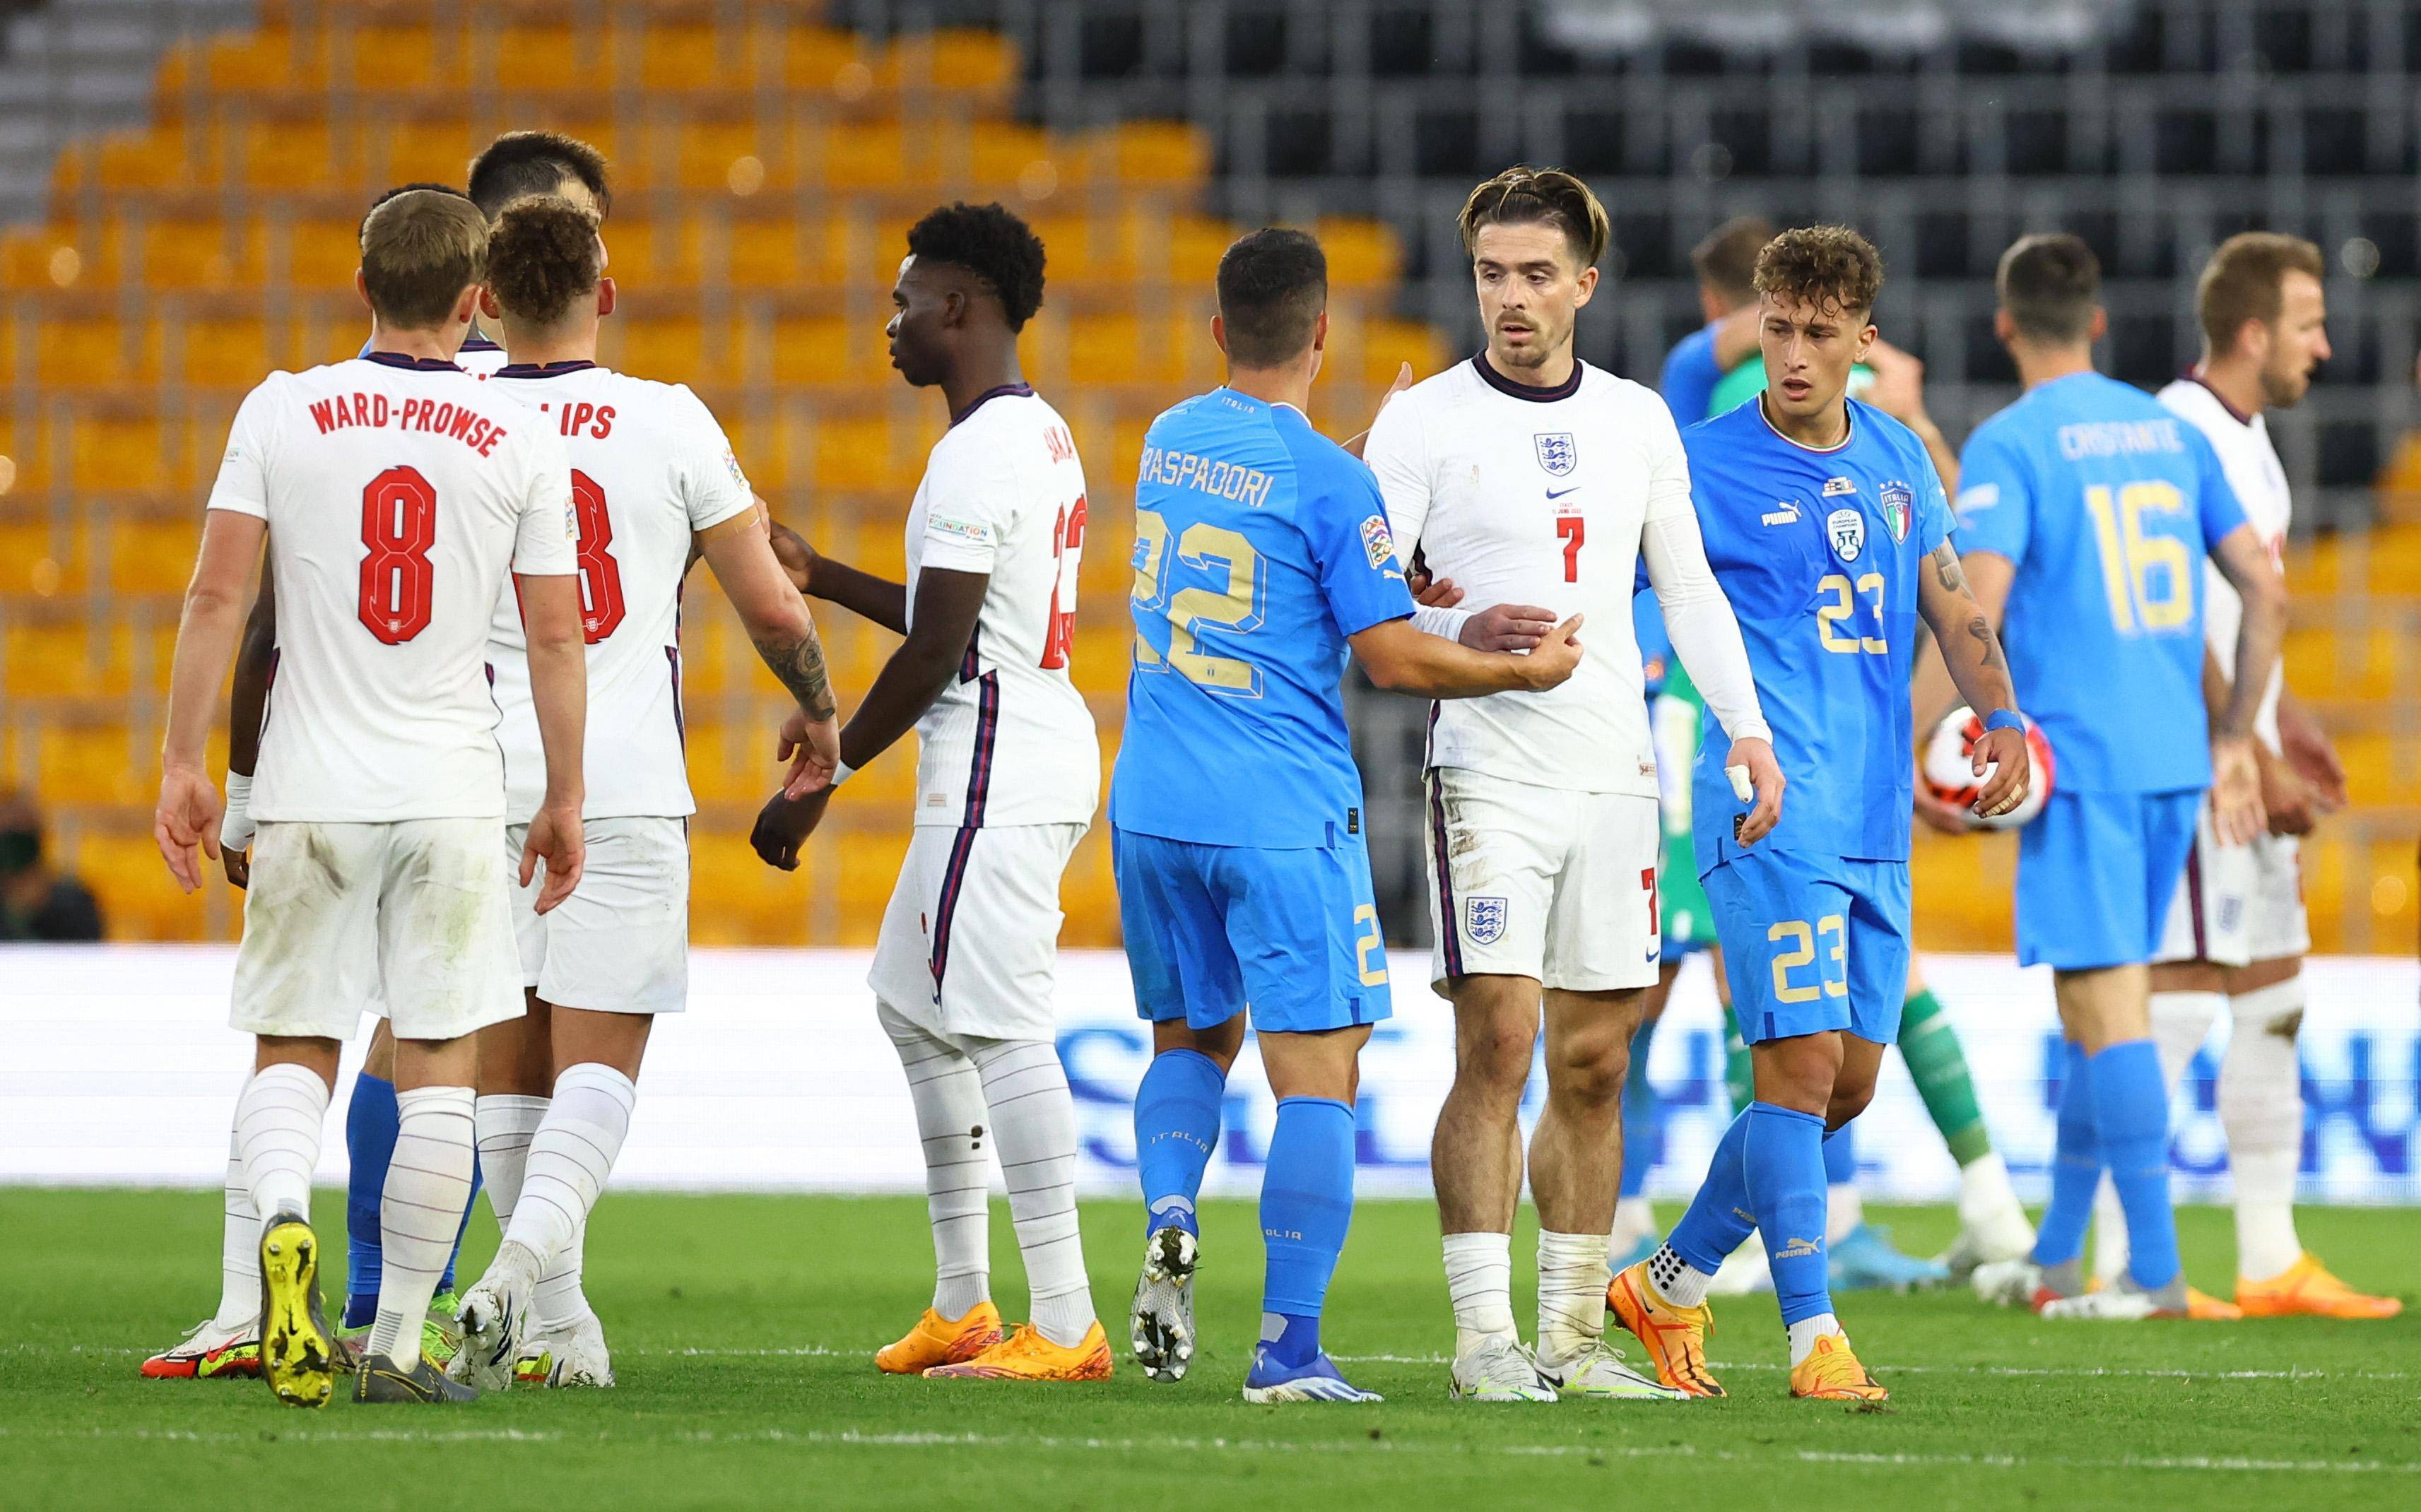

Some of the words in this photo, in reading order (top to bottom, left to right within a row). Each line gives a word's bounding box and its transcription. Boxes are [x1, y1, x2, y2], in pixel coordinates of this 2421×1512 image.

[308, 392, 507, 458] WARD-PROWSE
[1221, 396, 1255, 413] ITALIA
[1139, 447, 1275, 507] RASPADORI
[1885, 493, 1909, 503] ITALIA
[929, 518, 988, 537] FOUNDATION
[1557, 517, 1584, 583] 7
[1761, 511, 1798, 527] PUMA
[358, 465, 436, 645] 8
[2085, 480, 2192, 632] 16
[1816, 572, 1888, 654] 23
[1768, 914, 1849, 1003] 23
[1151, 1130, 1208, 1154] ITALIA
